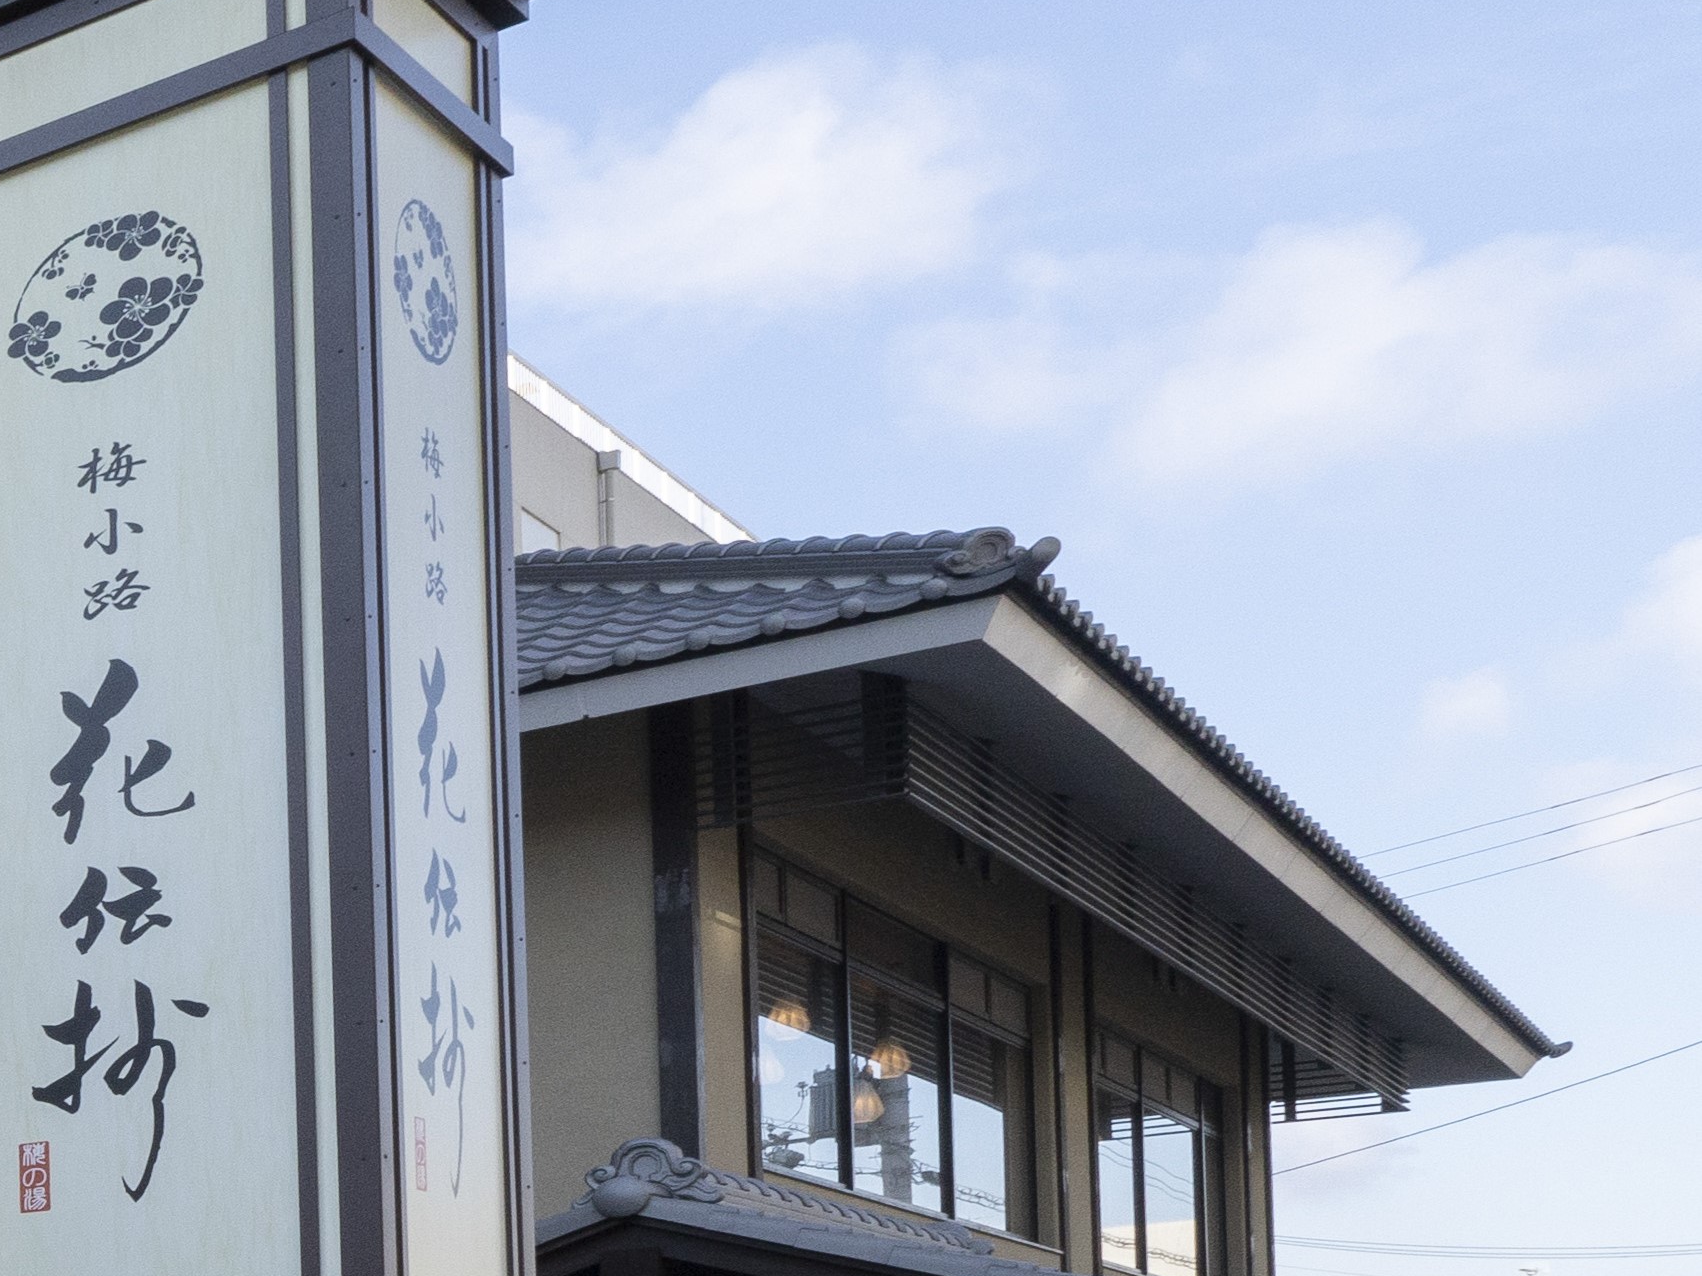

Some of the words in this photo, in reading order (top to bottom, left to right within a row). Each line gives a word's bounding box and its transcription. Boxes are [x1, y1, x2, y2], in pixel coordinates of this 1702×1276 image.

[76, 441, 152, 621] 梅小路
[420, 426, 449, 606] 梅小路
[32, 657, 210, 1203] 花伝抄
[417, 645, 475, 1200] 花伝抄
